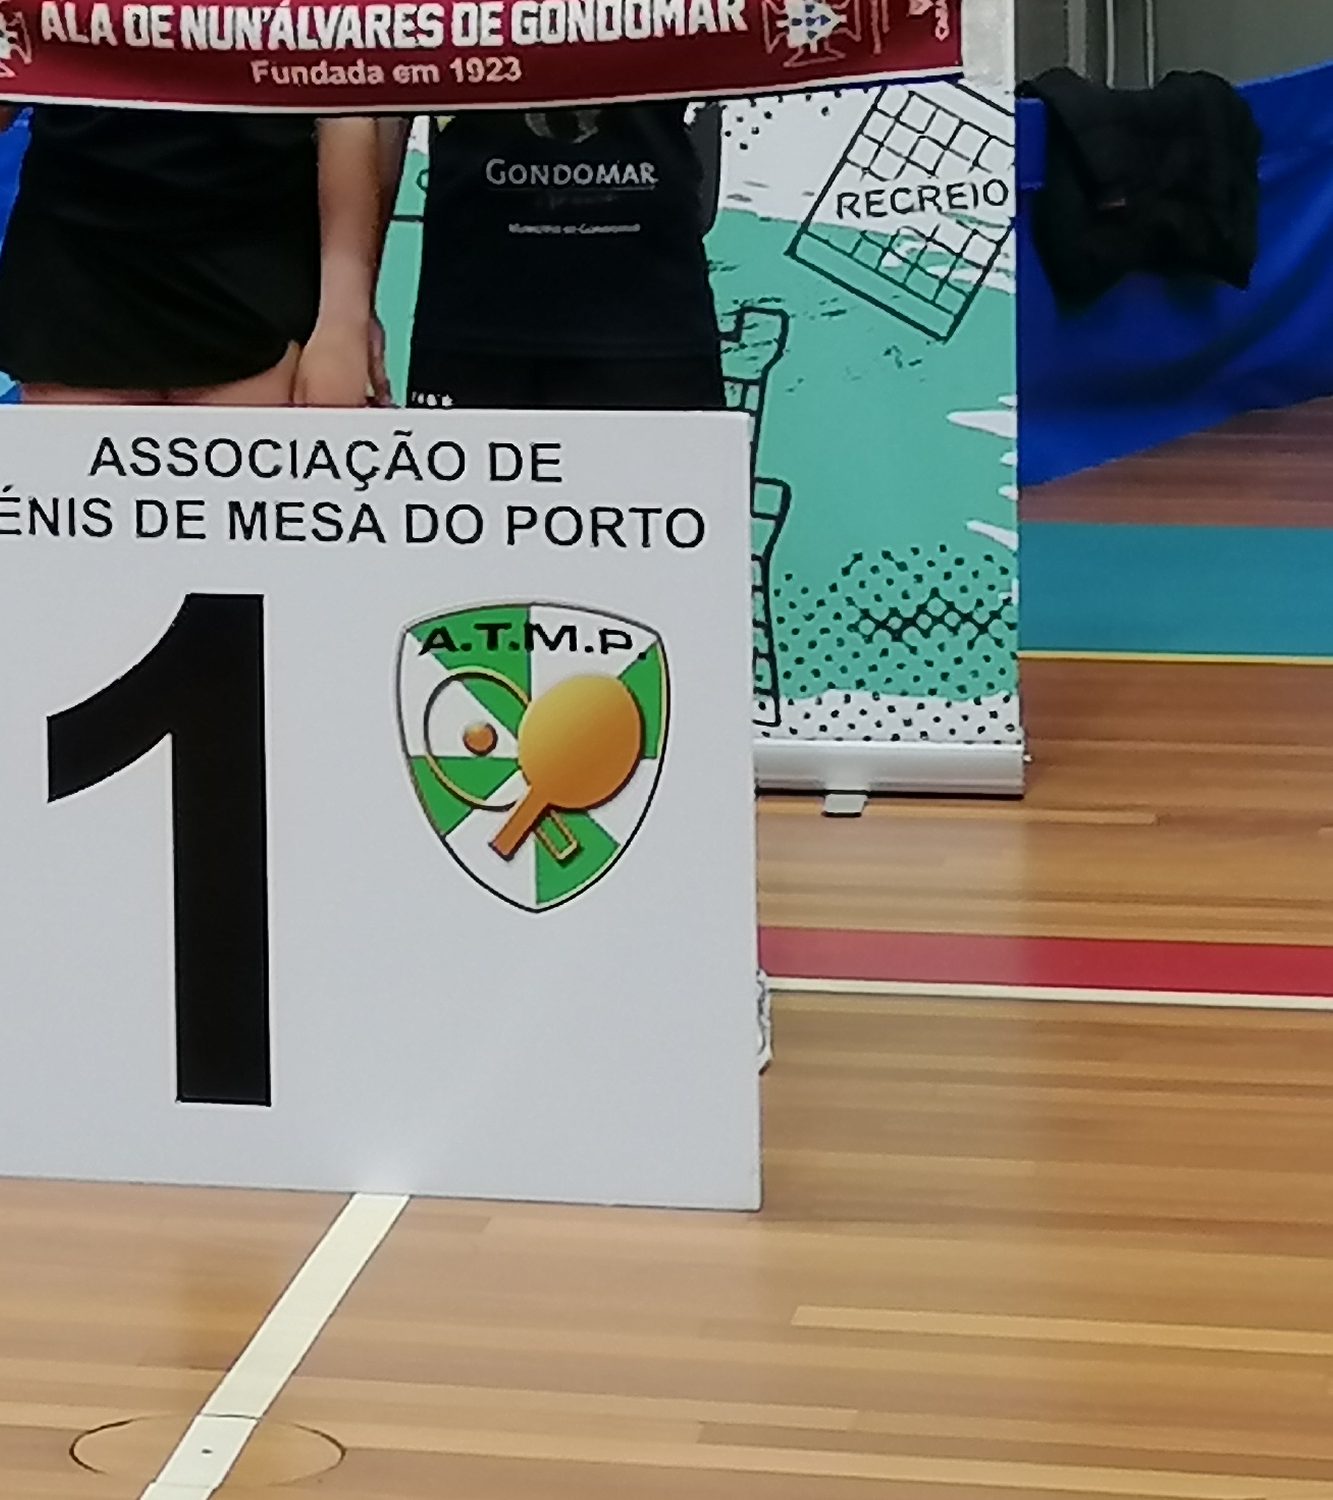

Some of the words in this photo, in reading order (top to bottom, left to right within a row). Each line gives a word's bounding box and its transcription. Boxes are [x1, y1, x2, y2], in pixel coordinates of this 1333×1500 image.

[40, 0, 118, 46] ALA
[123, 3, 175, 49] DE
[451, 2, 505, 48] DE
[251, 59, 384, 85] Fundada
[392, 62, 440, 85] em
[449, 56, 523, 84] 1923
[486, 158, 659, 185] GONDOMAR
[836, 178, 1010, 220] RECREIO
[88, 430, 468, 492] ASSOCIAÇÃO
[488, 442, 563, 484] DE
[135, 499, 208, 541] DE
[228, 501, 386, 546] MESA
[405, 504, 486, 547] DO
[506, 506, 707, 550] PORTO
[420, 621, 649, 662] A.T.M.P.
[47, 592, 272, 1107] 1
